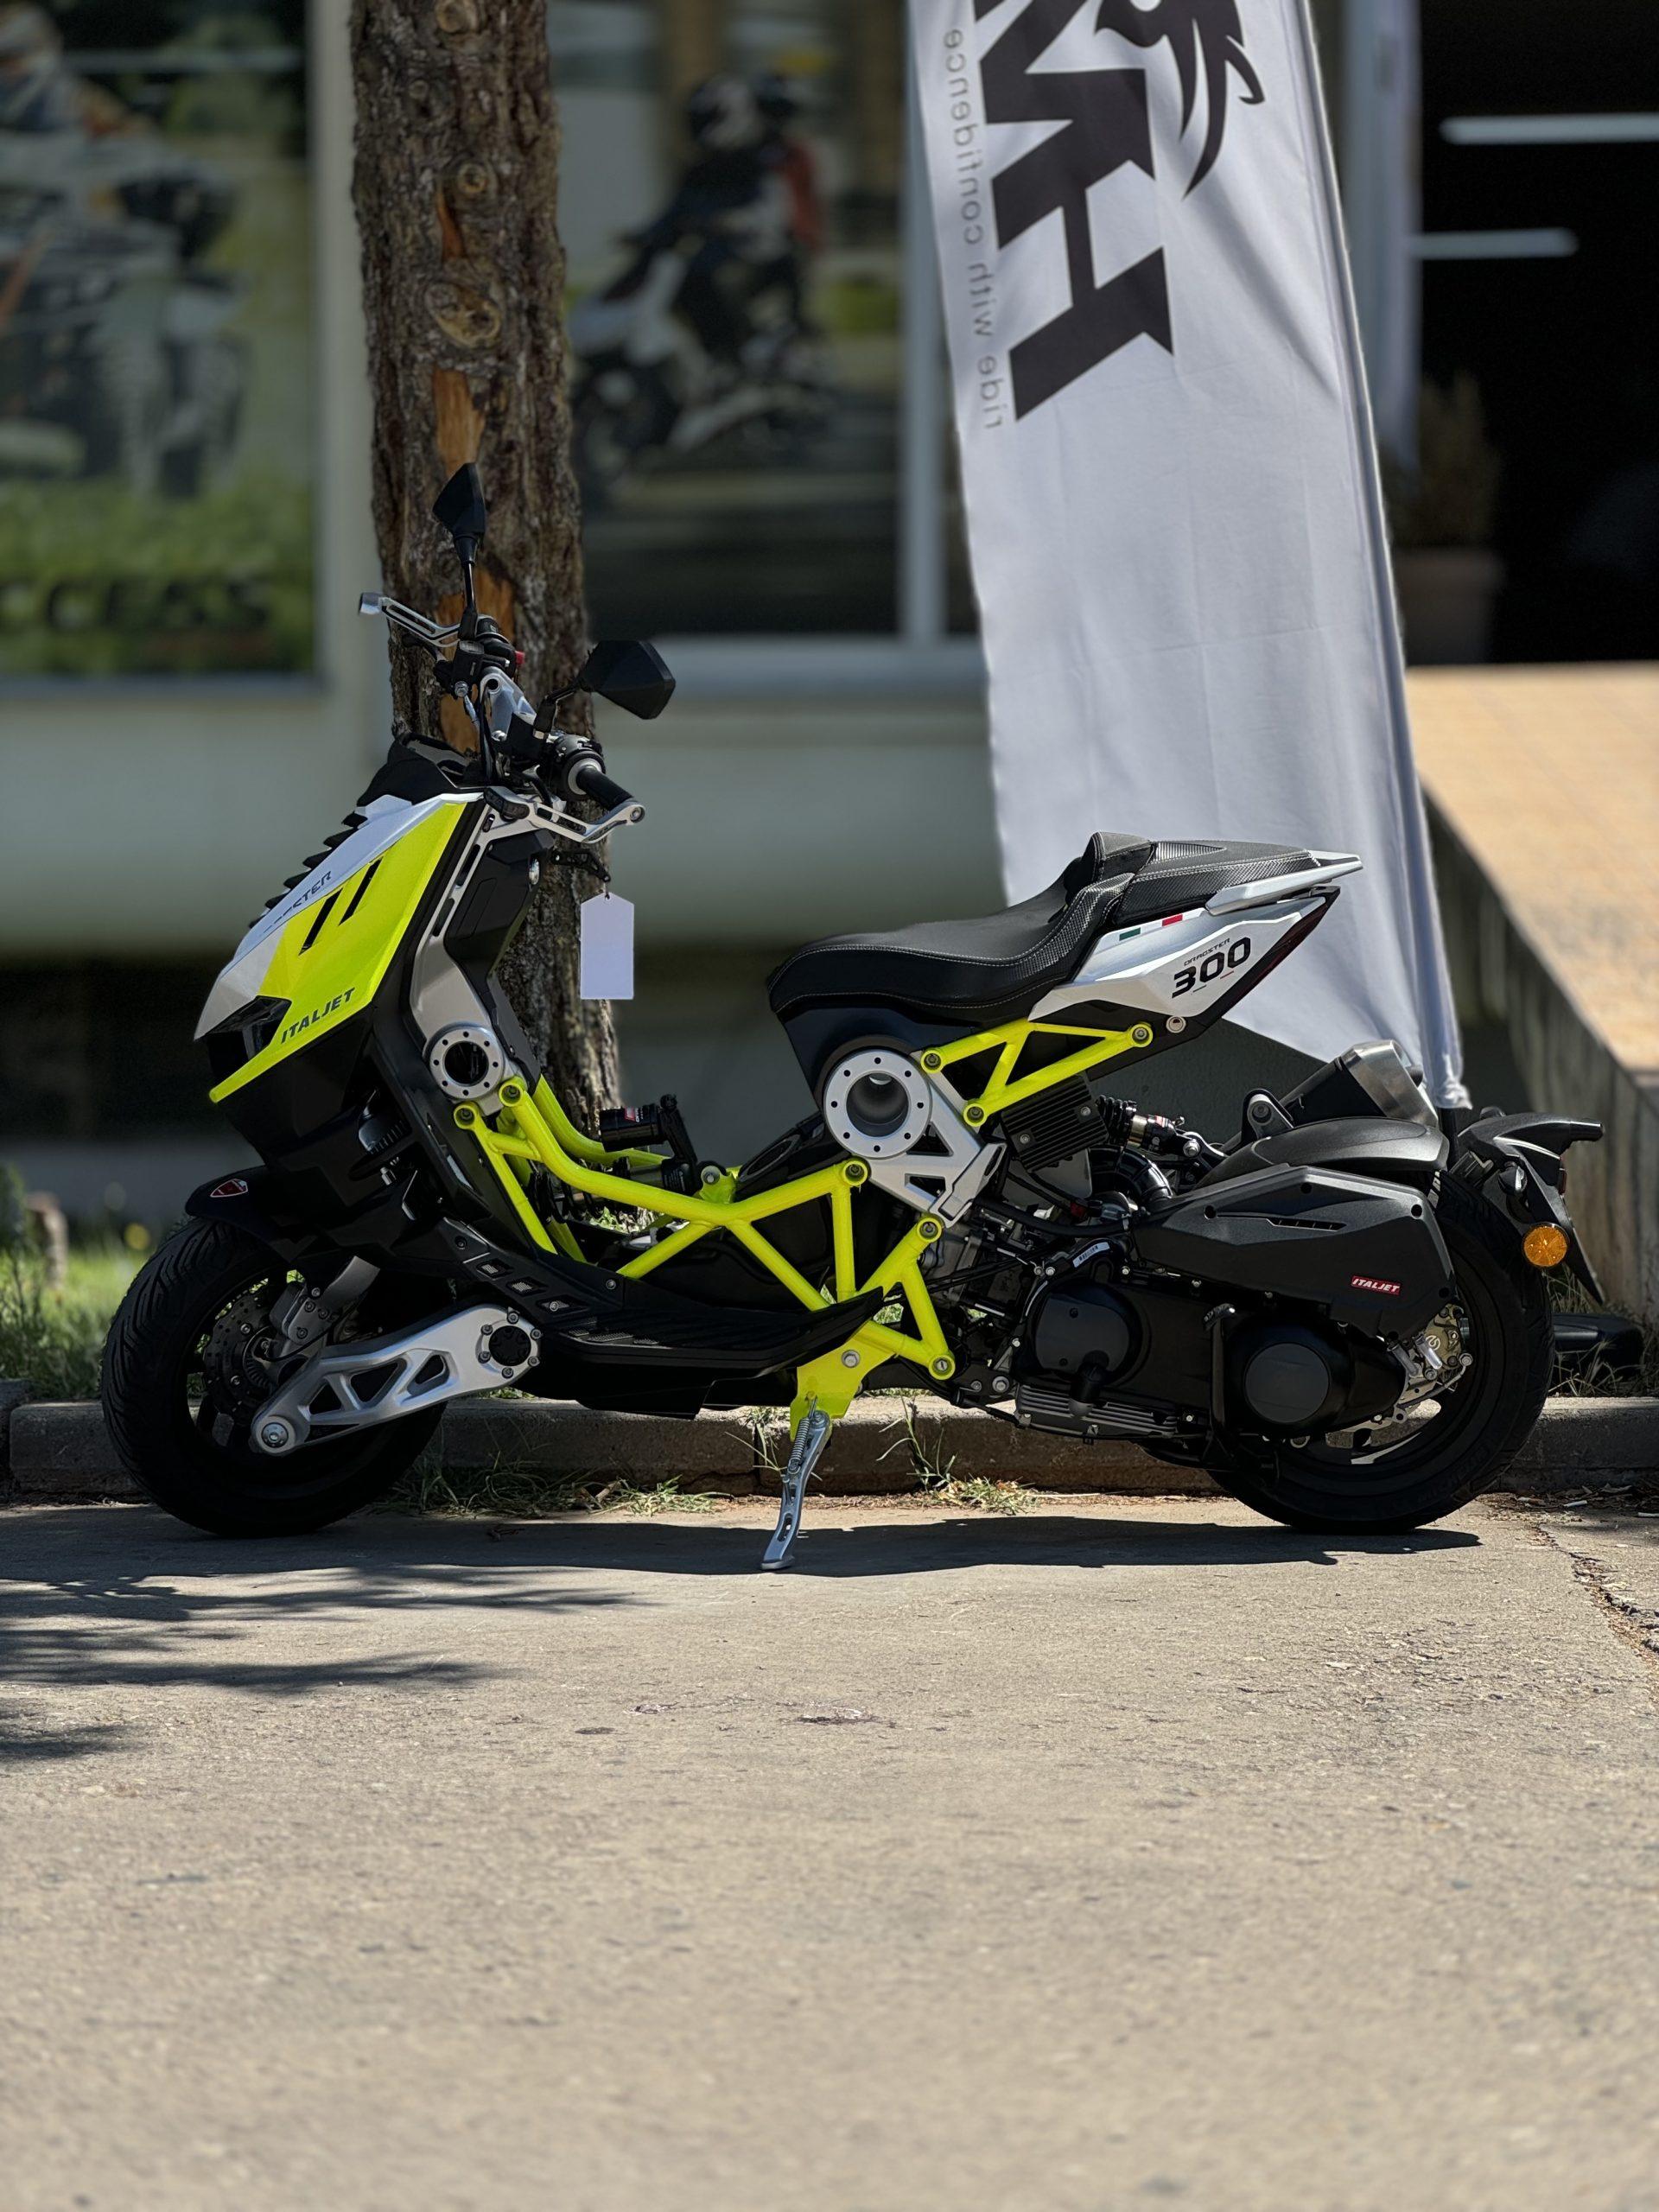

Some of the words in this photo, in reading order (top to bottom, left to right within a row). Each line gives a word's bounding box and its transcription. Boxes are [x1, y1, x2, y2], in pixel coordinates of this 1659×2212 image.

[1172, 936, 1251, 999] 300
[1184, 938, 1231, 966] DRAGSTER
[280, 987, 355, 1045] ITALJET
[1351, 1277, 1401, 1293] ITALJET
